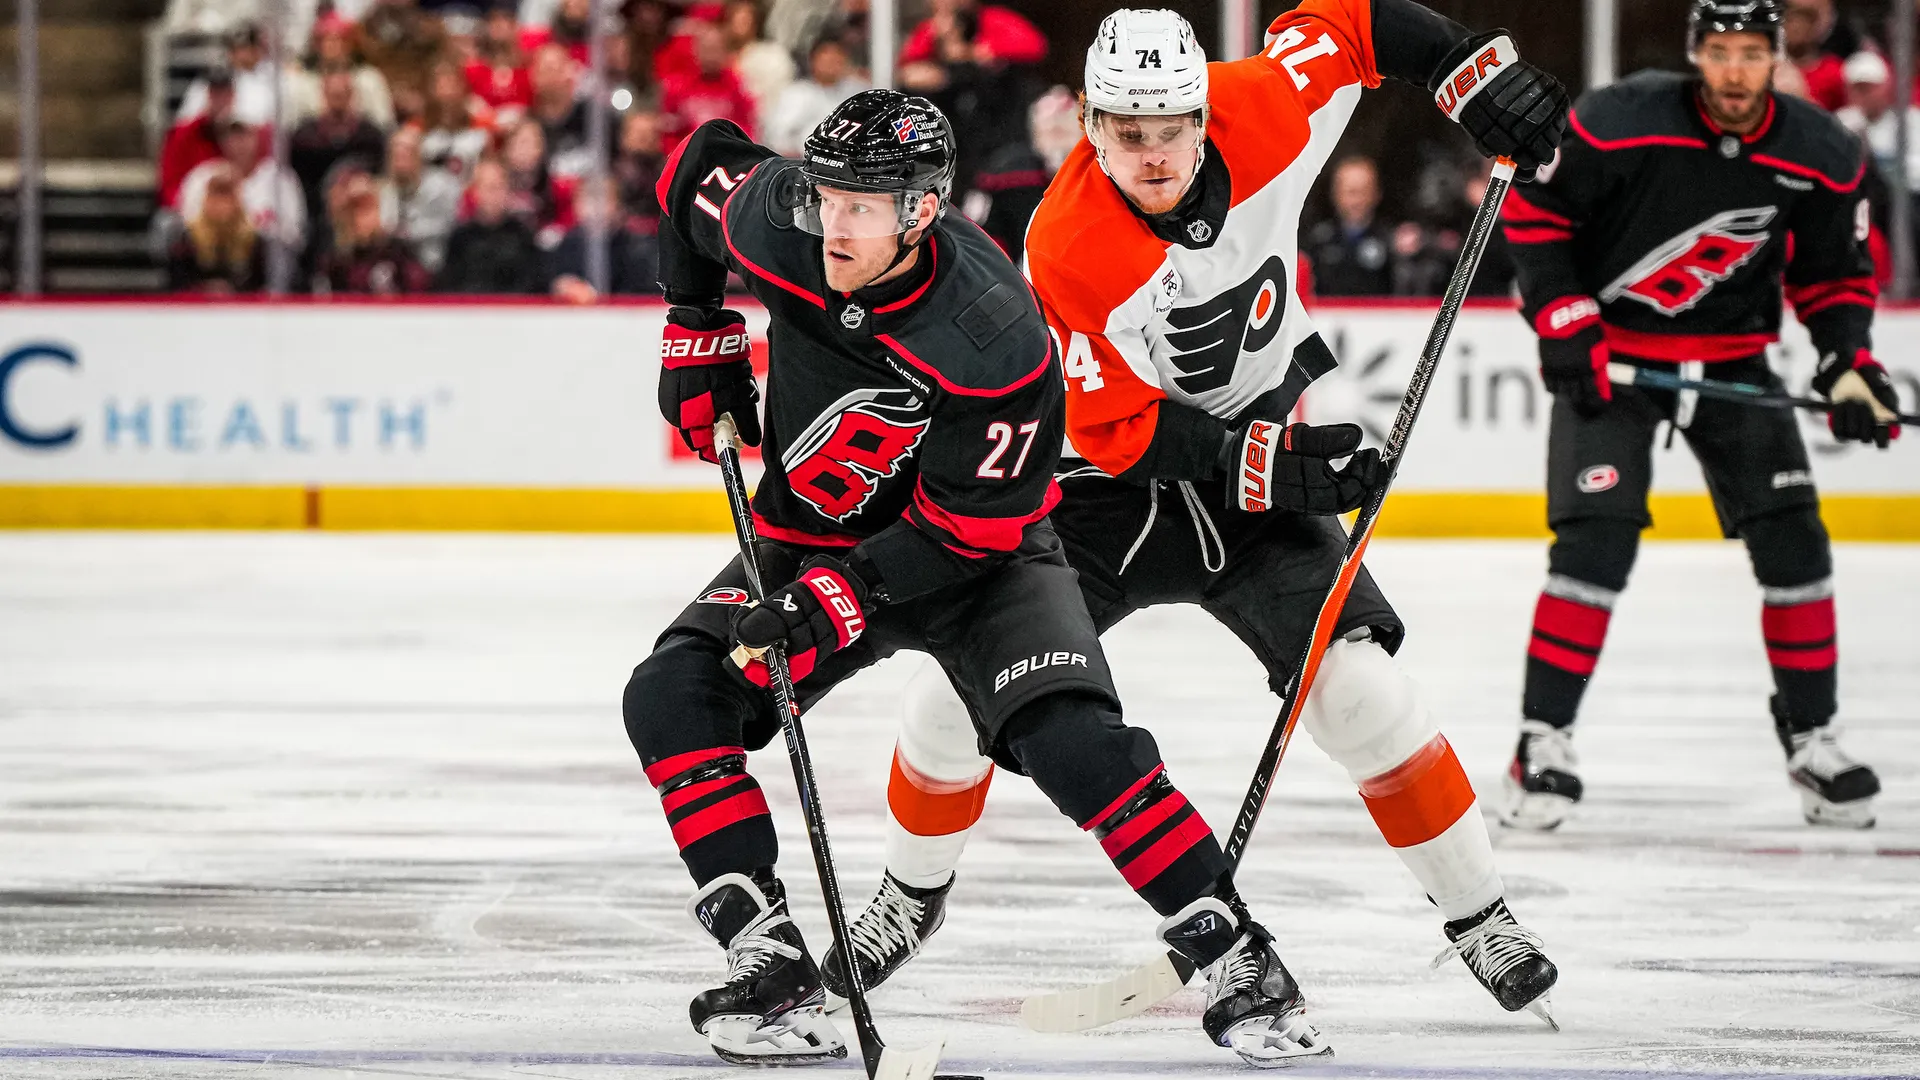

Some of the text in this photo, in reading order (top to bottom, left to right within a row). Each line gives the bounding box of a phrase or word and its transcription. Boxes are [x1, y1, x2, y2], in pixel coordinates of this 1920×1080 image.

[1135, 49, 1162, 69] 74
[1266, 23, 1339, 92] 74
[1128, 88, 1169, 96] BAUER
[1438, 46, 1502, 118] UER
[828, 119, 862, 141] 27
[911, 113, 928, 123] First
[811, 155, 845, 169] BAUER
[660, 332, 752, 358] BAUER
[886, 356, 930, 394] NUCOR
[104, 397, 428, 452] HEALTH
[976, 419, 1040, 479] 27
[810, 575, 864, 648] BAU
[994, 651, 1088, 694] BAUER
[1229, 773, 1267, 860] FLYLITE
[700, 905, 714, 930] 27
[1195, 913, 1216, 935] 27
